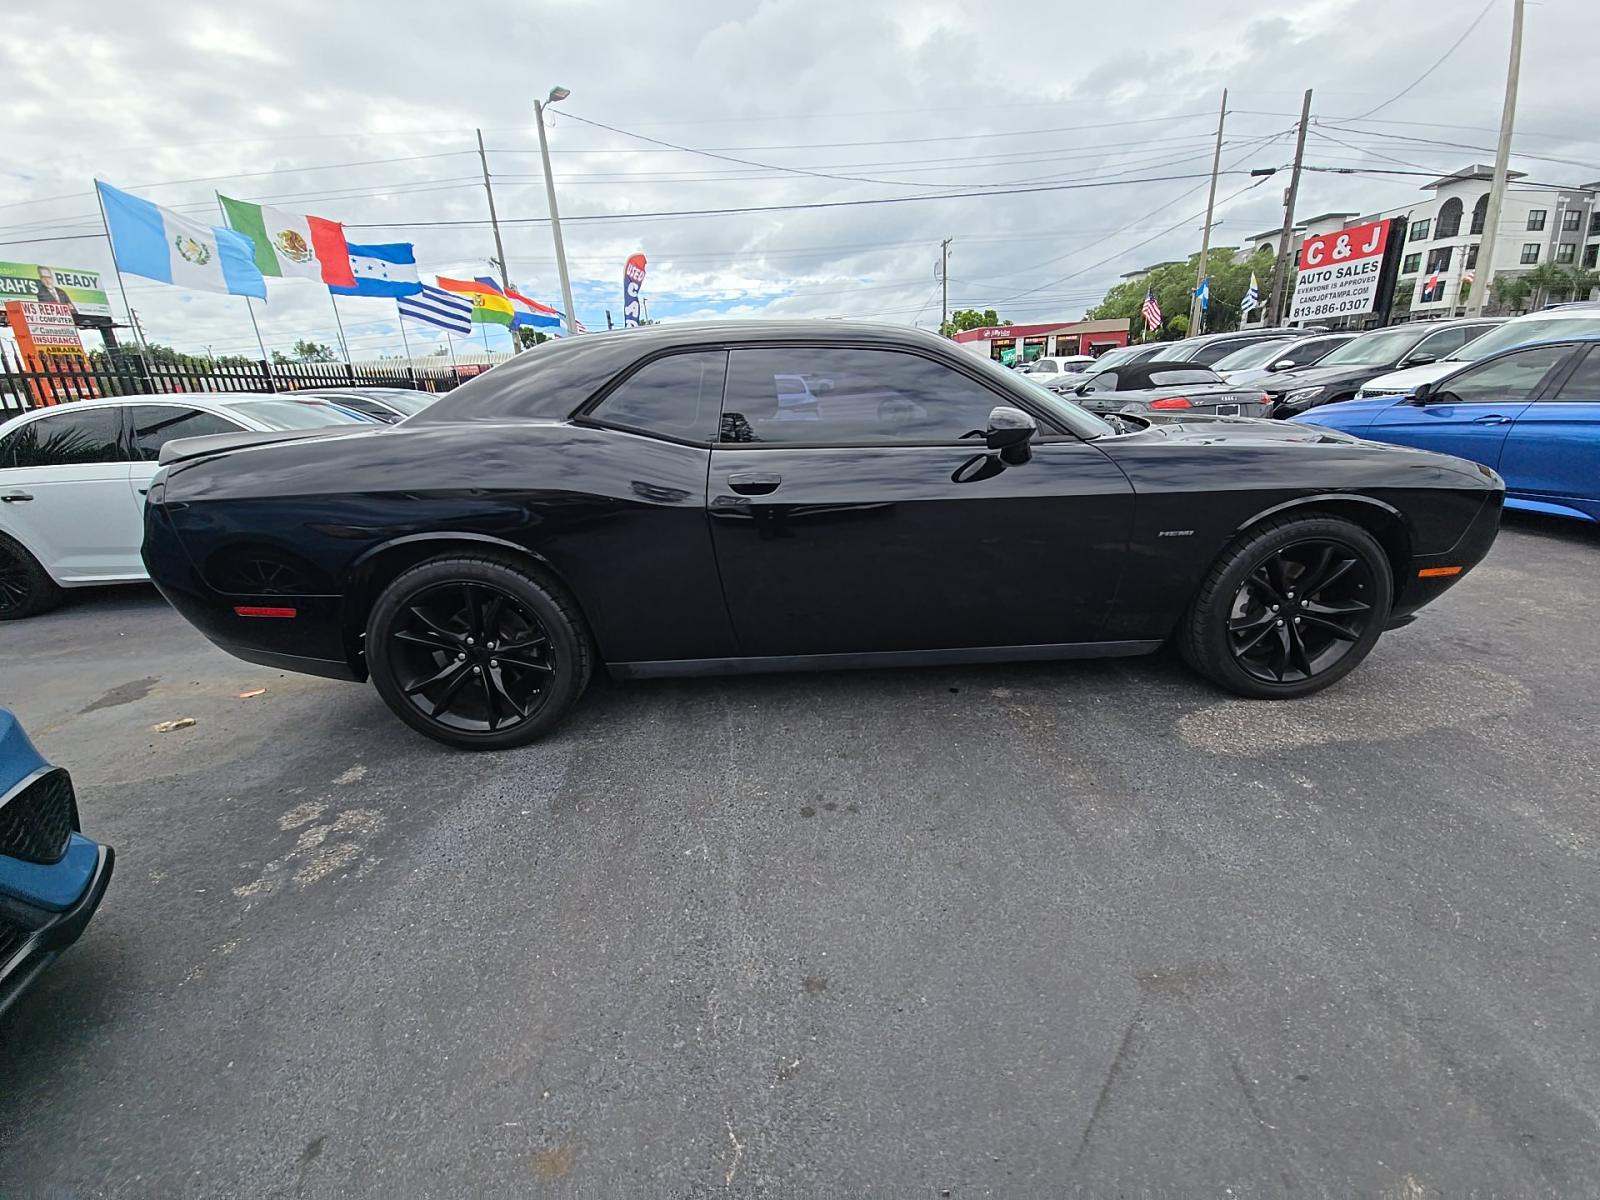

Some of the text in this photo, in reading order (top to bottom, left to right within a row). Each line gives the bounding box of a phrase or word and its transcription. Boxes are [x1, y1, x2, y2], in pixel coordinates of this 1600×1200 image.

[1307, 226, 1381, 265] C & J
[54, 272, 98, 289] READY
[627, 263, 646, 282] USED
[1299, 260, 1379, 286] AUTO SALES
[1297, 283, 1330, 295] EVERYONE
[1339, 275, 1376, 288] APPROVED
[1299, 286, 1370, 304] CANDJOFTAMPA.COM
[38, 304, 71, 317] REPAIR
[1293, 298, 1370, 318] 813-886-0307
[39, 316, 74, 325] COMPUTER
[33, 336, 80, 345] INSURANCE
